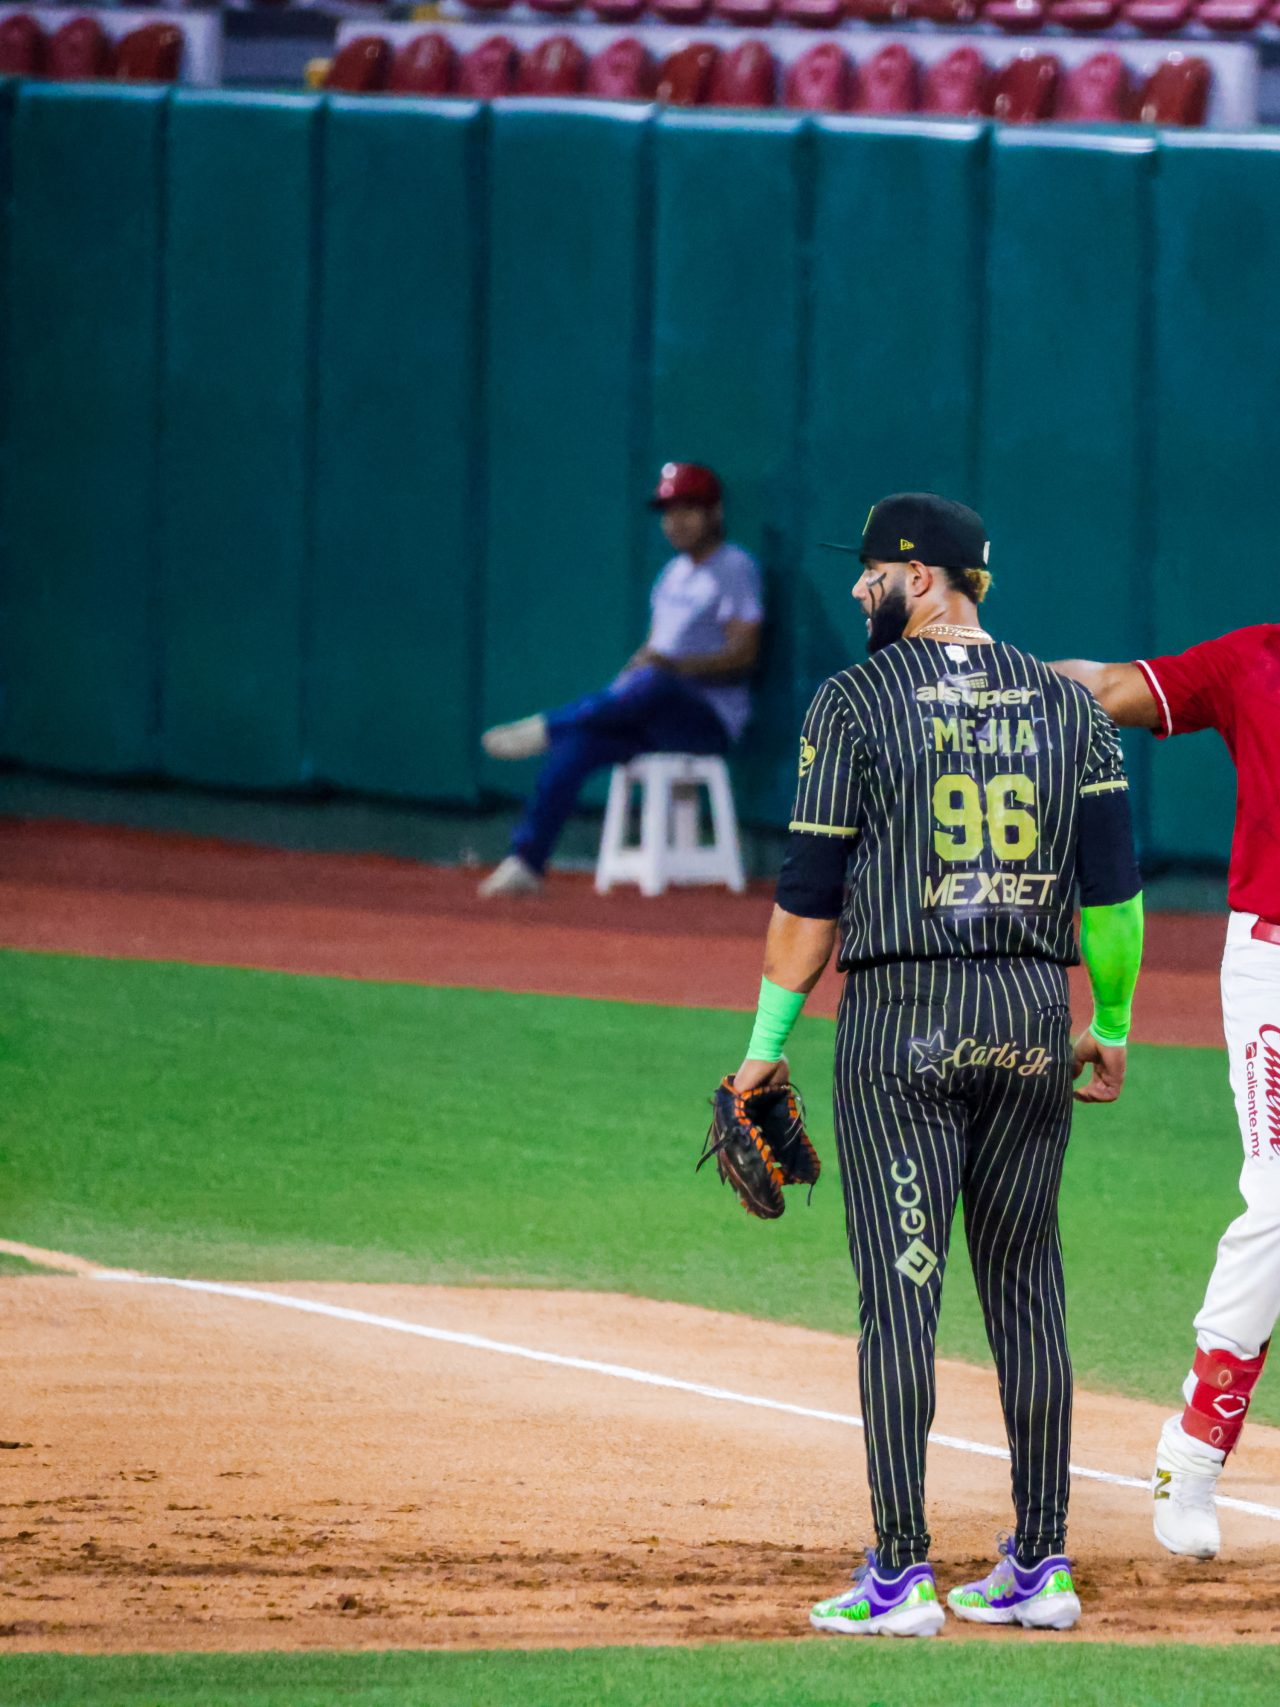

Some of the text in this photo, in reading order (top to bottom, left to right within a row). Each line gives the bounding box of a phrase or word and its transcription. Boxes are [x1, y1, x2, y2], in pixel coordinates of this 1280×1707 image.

[932, 716, 1040, 754] MEJIA
[932, 773, 1039, 862] 96
[922, 872, 1058, 909] MEXBET
[1246, 1061, 1260, 1158] caliente.mx
[891, 1158, 926, 1235] GCC
